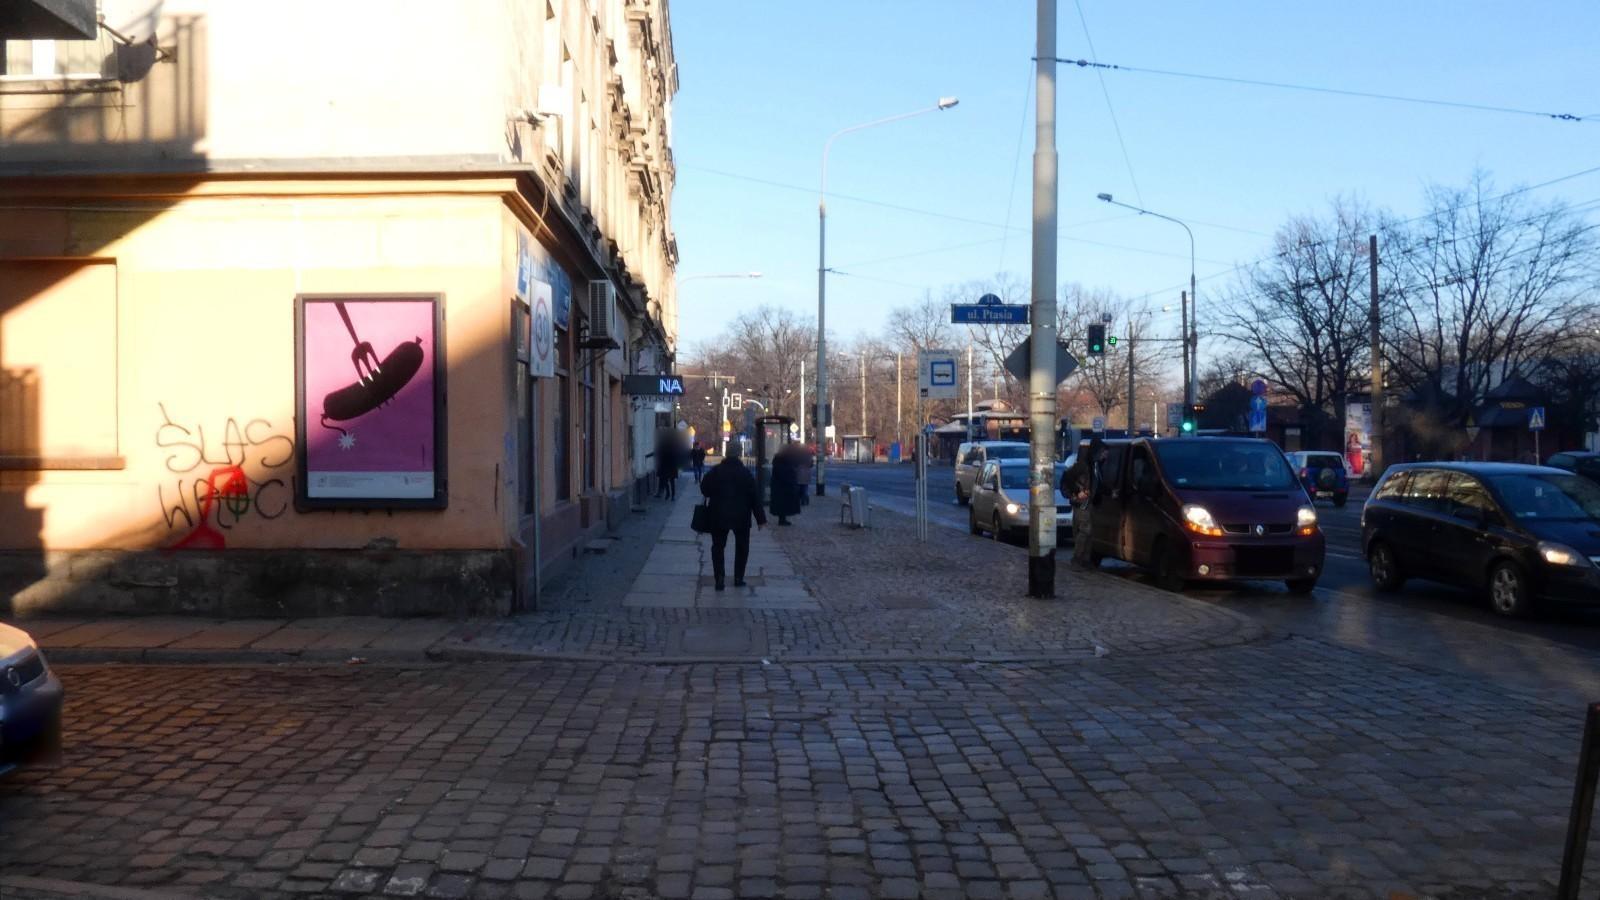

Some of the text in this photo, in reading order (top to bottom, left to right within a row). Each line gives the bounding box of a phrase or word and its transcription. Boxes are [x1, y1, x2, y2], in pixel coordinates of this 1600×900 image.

[968, 309, 1012, 320] ul. Ptasia
[659, 378, 683, 393] NA
